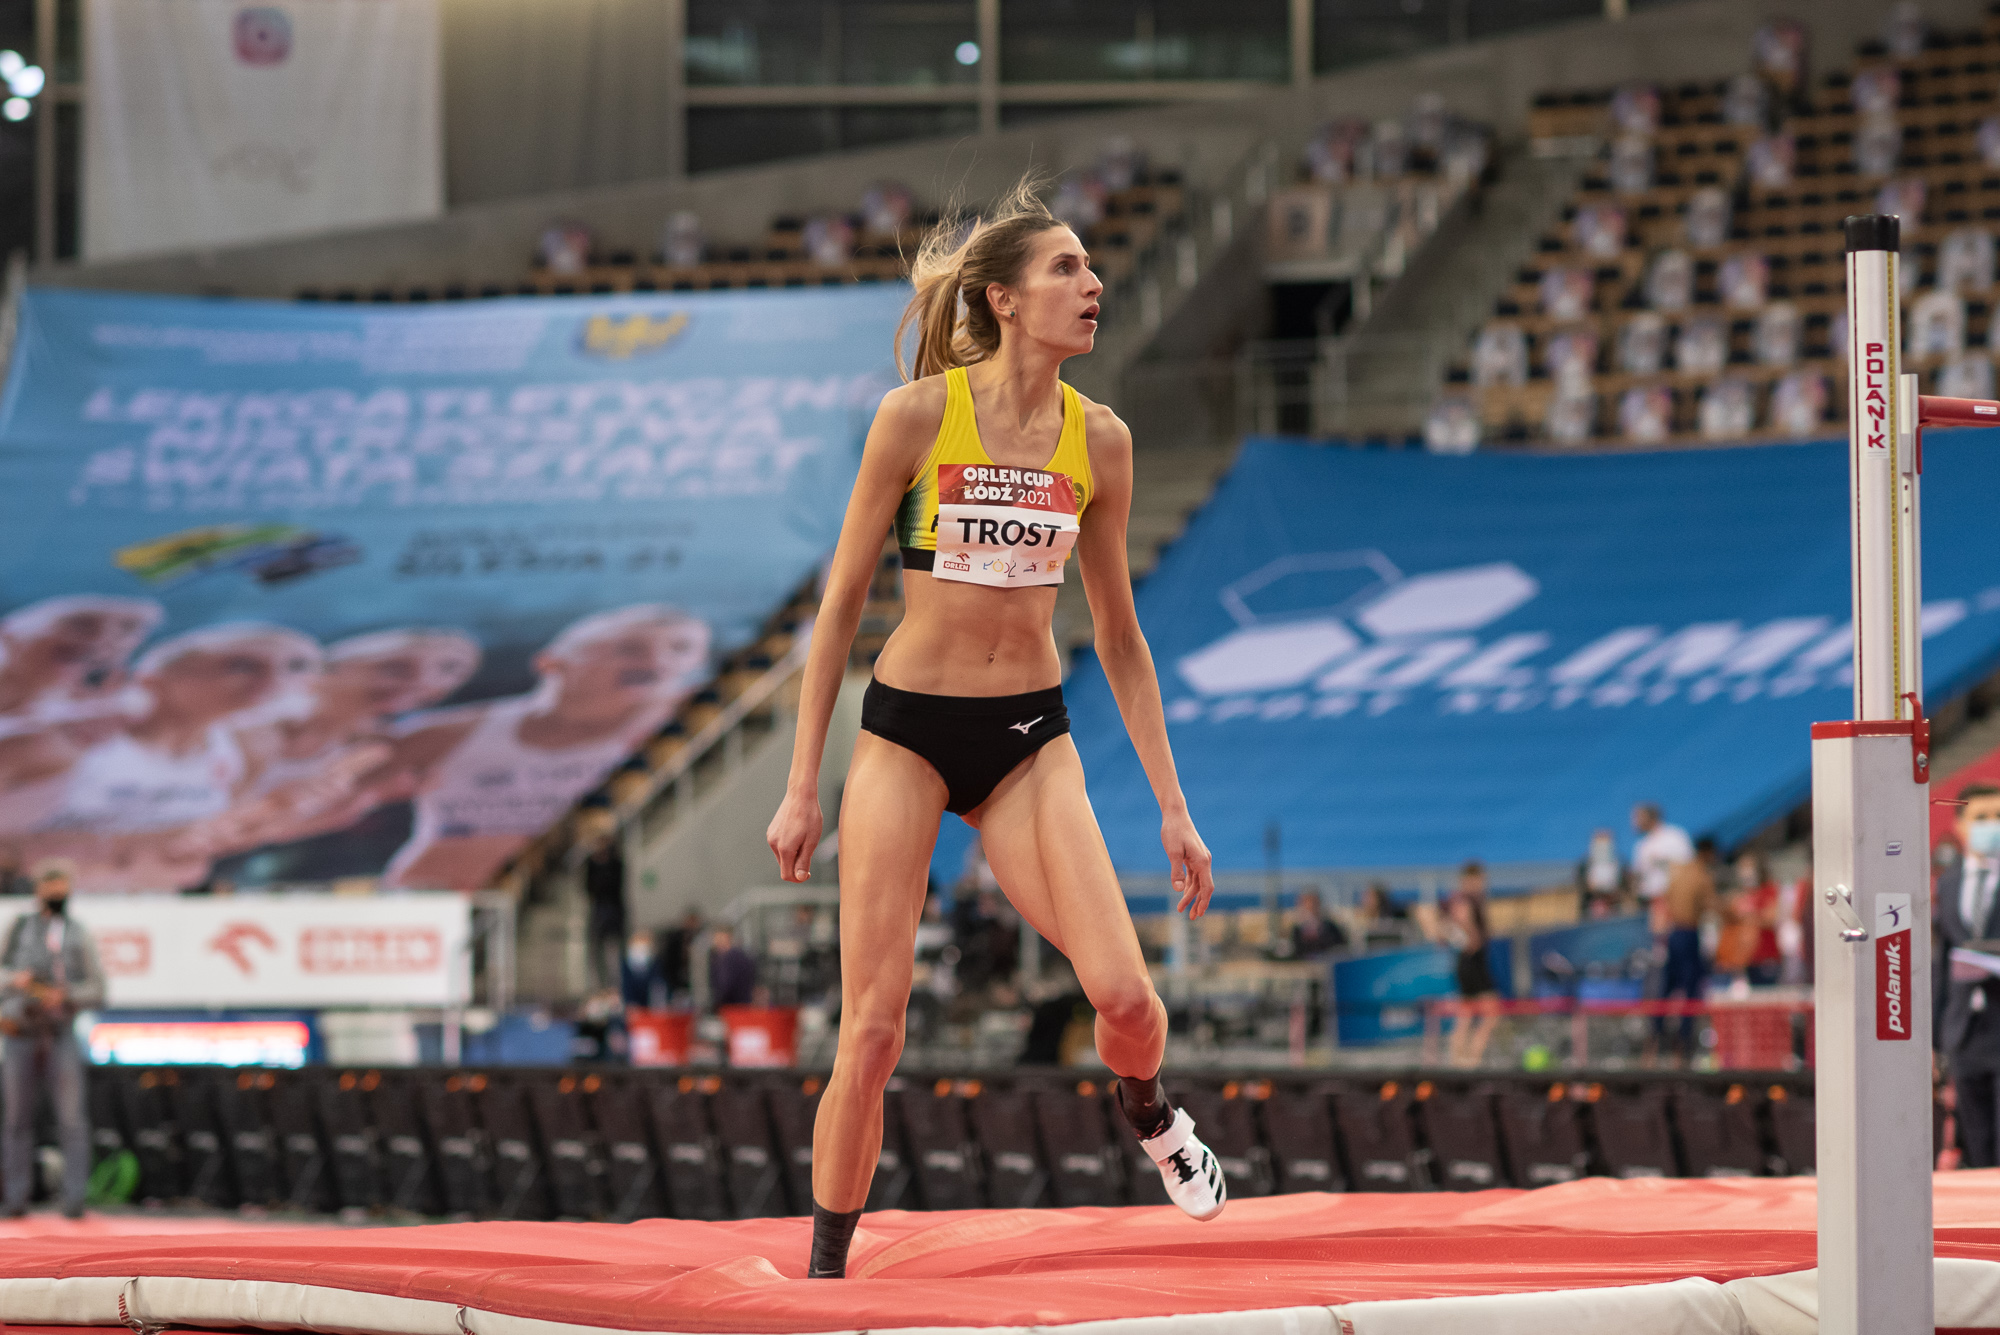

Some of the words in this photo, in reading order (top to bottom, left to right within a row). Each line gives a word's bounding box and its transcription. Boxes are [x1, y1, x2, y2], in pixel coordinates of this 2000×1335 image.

[1866, 343, 1887, 449] POLANIK
[963, 467, 1022, 485] ORLEN
[1023, 472, 1054, 488] CUP
[963, 484, 1014, 501] ŁÓDŹ
[1018, 489, 1052, 506] 2021
[957, 518, 1062, 548] TROST
[944, 562, 969, 572] ORLEN
[1884, 941, 1905, 1034] polanik
